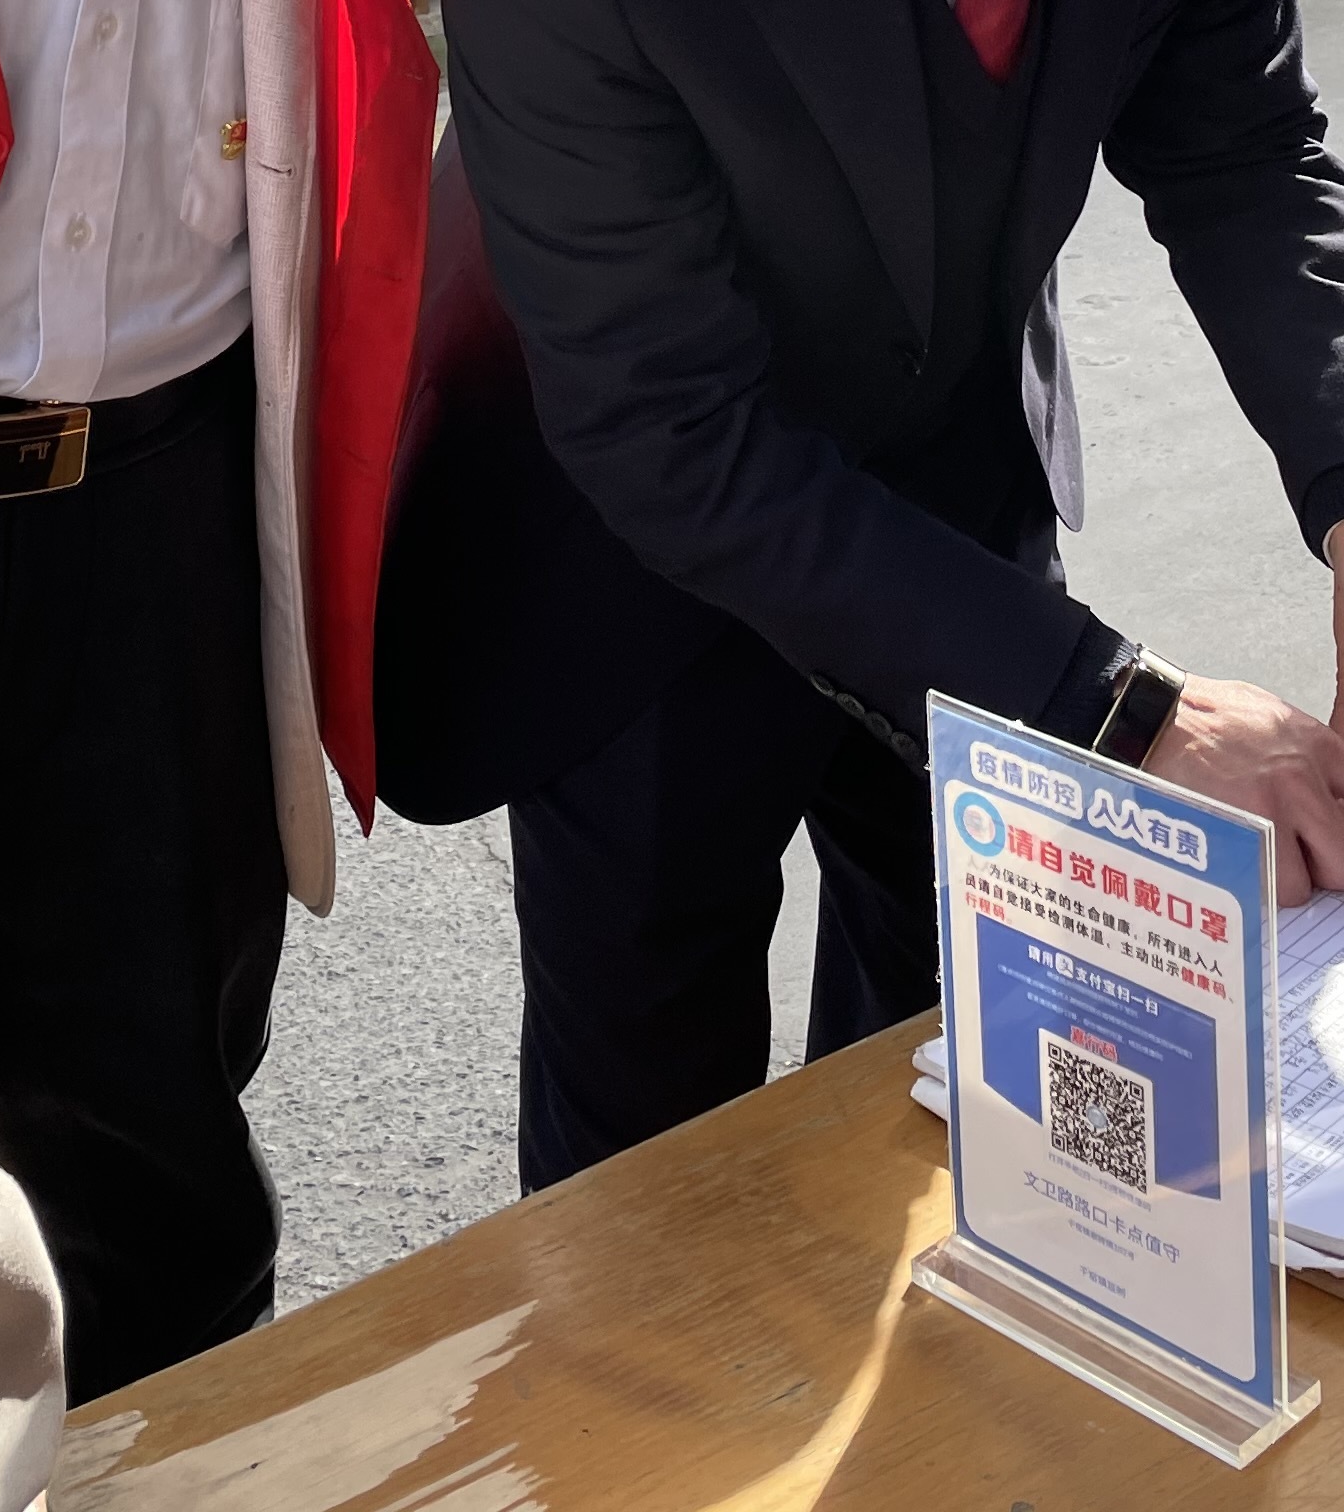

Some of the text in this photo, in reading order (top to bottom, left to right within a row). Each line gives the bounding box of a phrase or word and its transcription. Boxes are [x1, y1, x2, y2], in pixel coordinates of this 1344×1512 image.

[974, 746, 1204, 868] 疫情防控 人人有责
[1006, 823, 1229, 944] 请自觉佩戴口罩
[1022, 1170, 1182, 1264] 文卫路路口卡点值守
